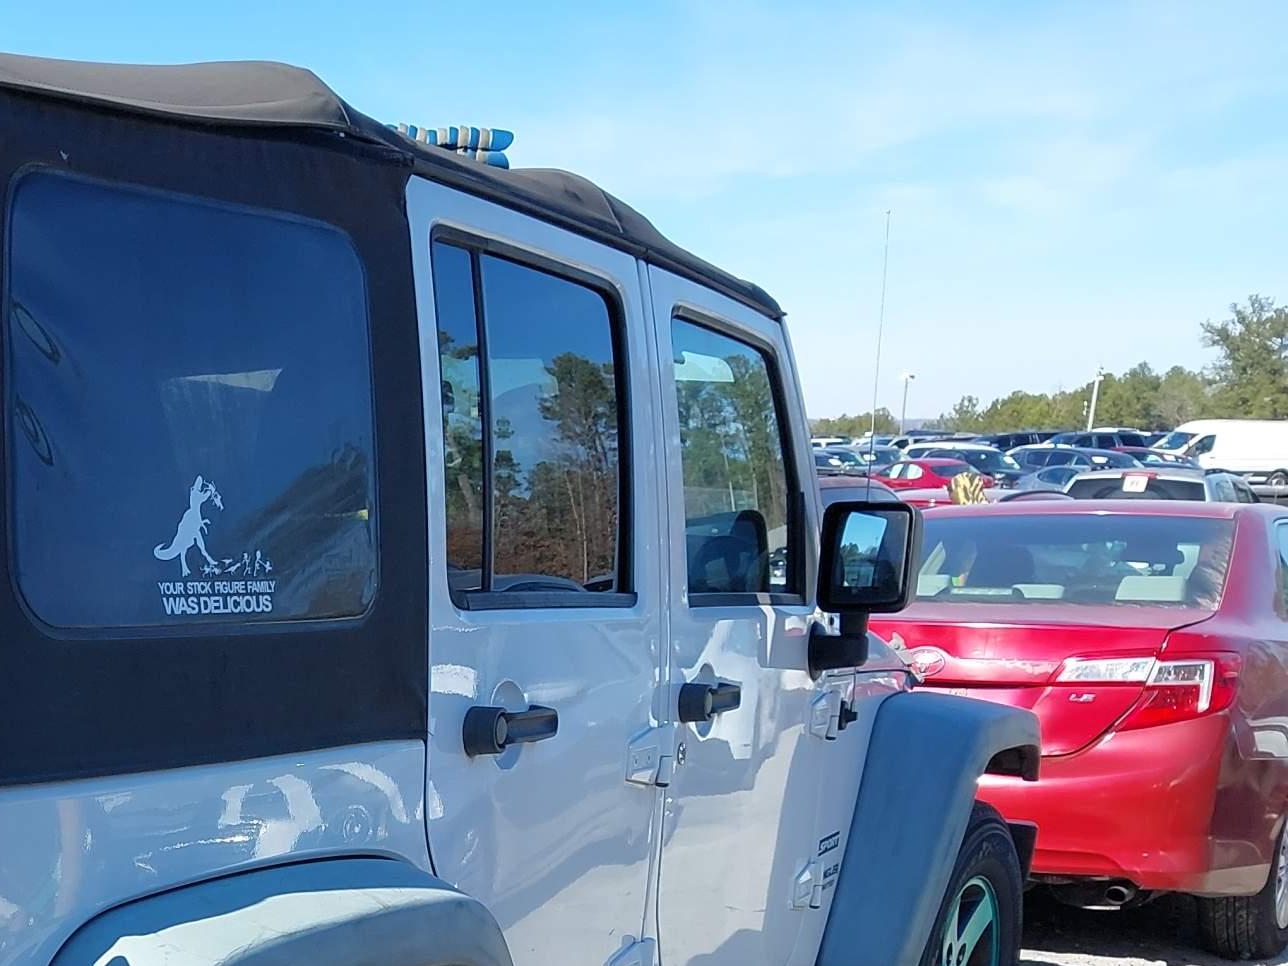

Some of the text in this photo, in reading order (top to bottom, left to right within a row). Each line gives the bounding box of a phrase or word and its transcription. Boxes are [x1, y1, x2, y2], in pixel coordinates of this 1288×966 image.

[158, 580, 276, 595] YOUR STICK FIGURE FAMILY
[162, 595, 273, 615] WAS DELICIOUS
[1069, 693, 1097, 702] LE
